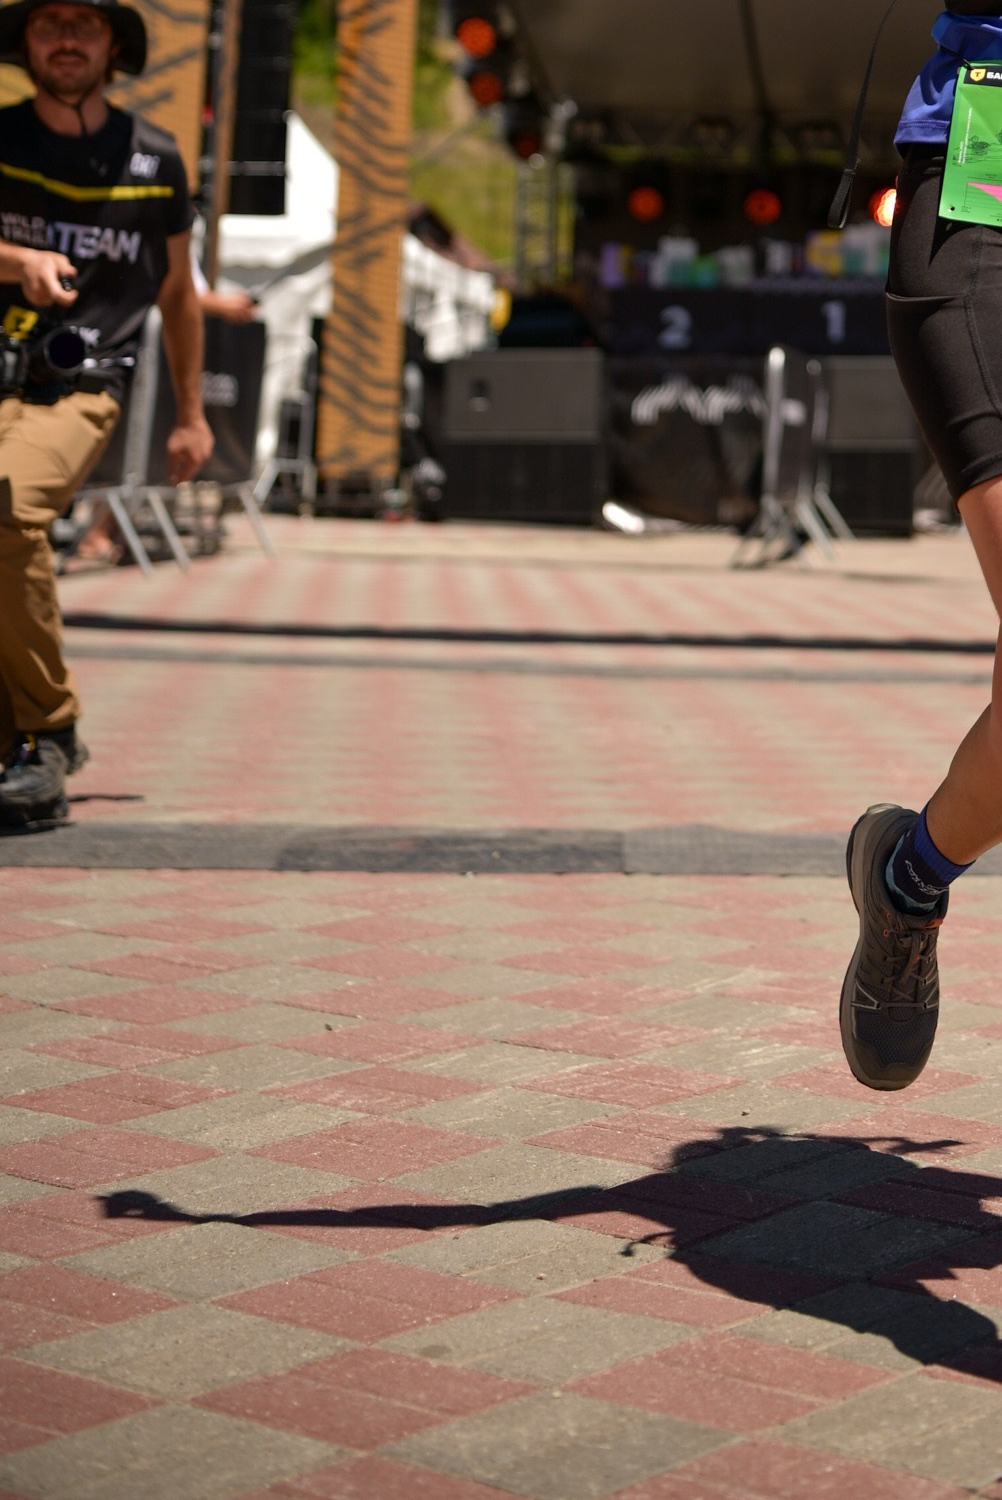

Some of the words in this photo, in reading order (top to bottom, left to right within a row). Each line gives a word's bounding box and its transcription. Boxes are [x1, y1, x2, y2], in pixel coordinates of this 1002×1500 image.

[53, 221, 142, 264] TEAM
[657, 304, 693, 348] 2
[821, 300, 847, 344] 1
